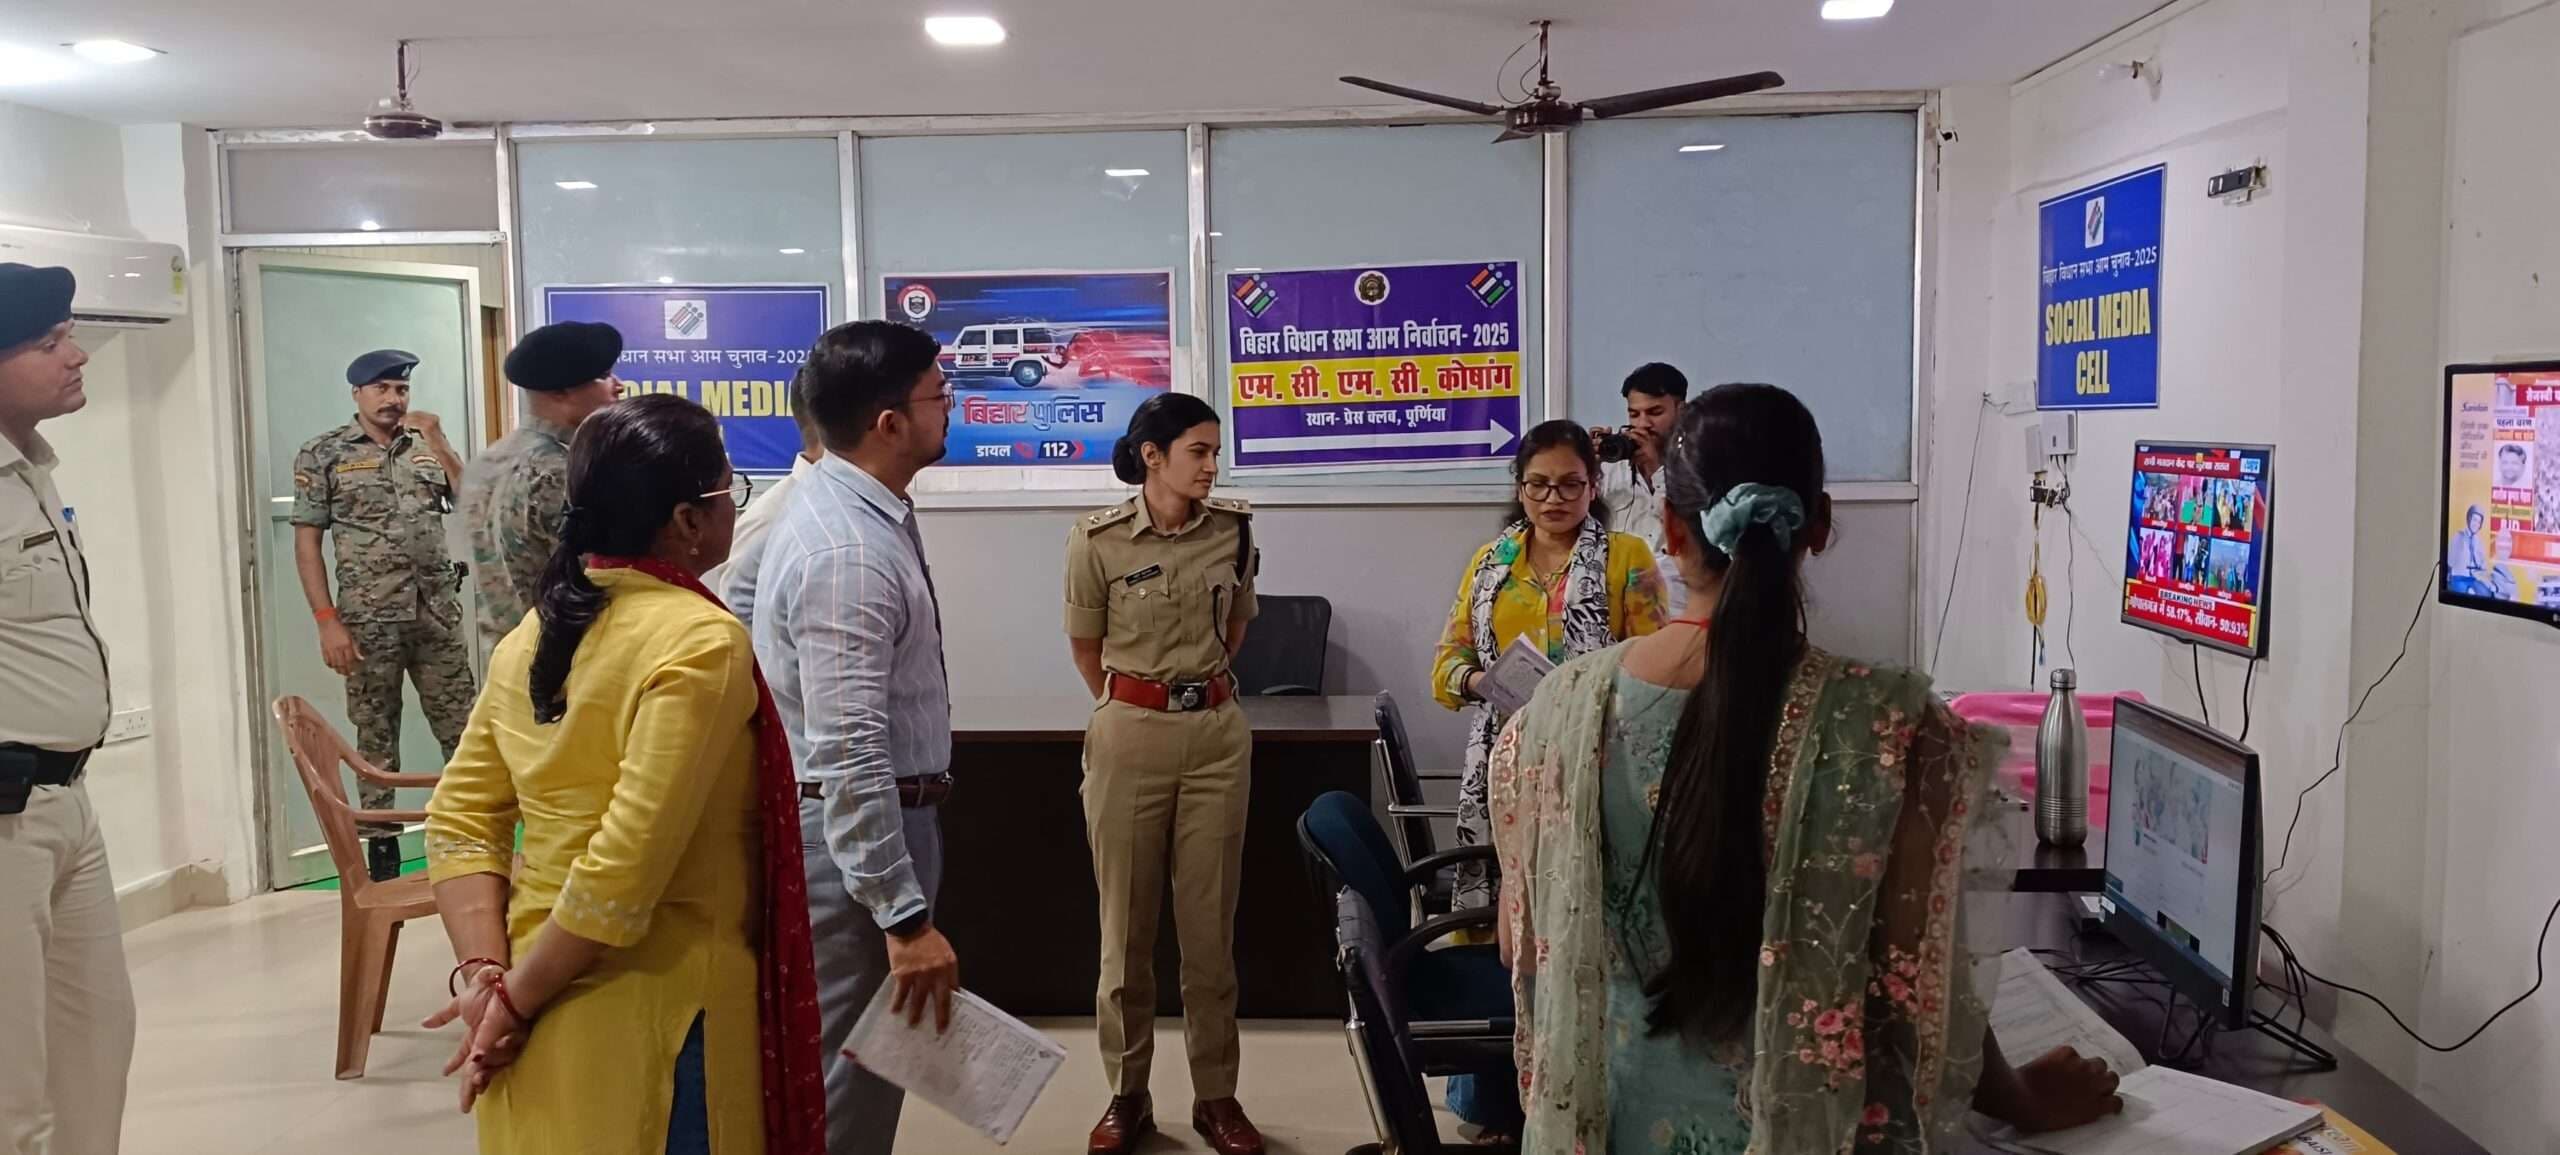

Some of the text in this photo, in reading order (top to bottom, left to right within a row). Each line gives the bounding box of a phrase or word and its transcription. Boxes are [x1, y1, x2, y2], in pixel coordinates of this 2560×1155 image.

[2079, 260, 2094, 278] सभा
[2095, 256, 2109, 273] आम
[2045, 287, 2151, 347] SOCIAL MEDIA
[1239, 327, 1280, 355] बिहार
[1283, 325, 1329, 353] विधान
[1332, 326, 1362, 352] सभा
[1367, 326, 1400, 350] आम
[1473, 322, 1509, 347] 2025
[654, 350, 685, 364] सभा
[691, 350, 721, 364] आम
[2076, 349, 2111, 396] CELL
[1238, 358, 1513, 400] एम. सी. एम. सी. कोषांग
[962, 395, 1106, 431] बिहार पुलिस
[1343, 409, 1364, 426] प्रेस
[1406, 404, 1447, 428] पूर्णिया
[976, 442, 1069, 458] डायल 112
